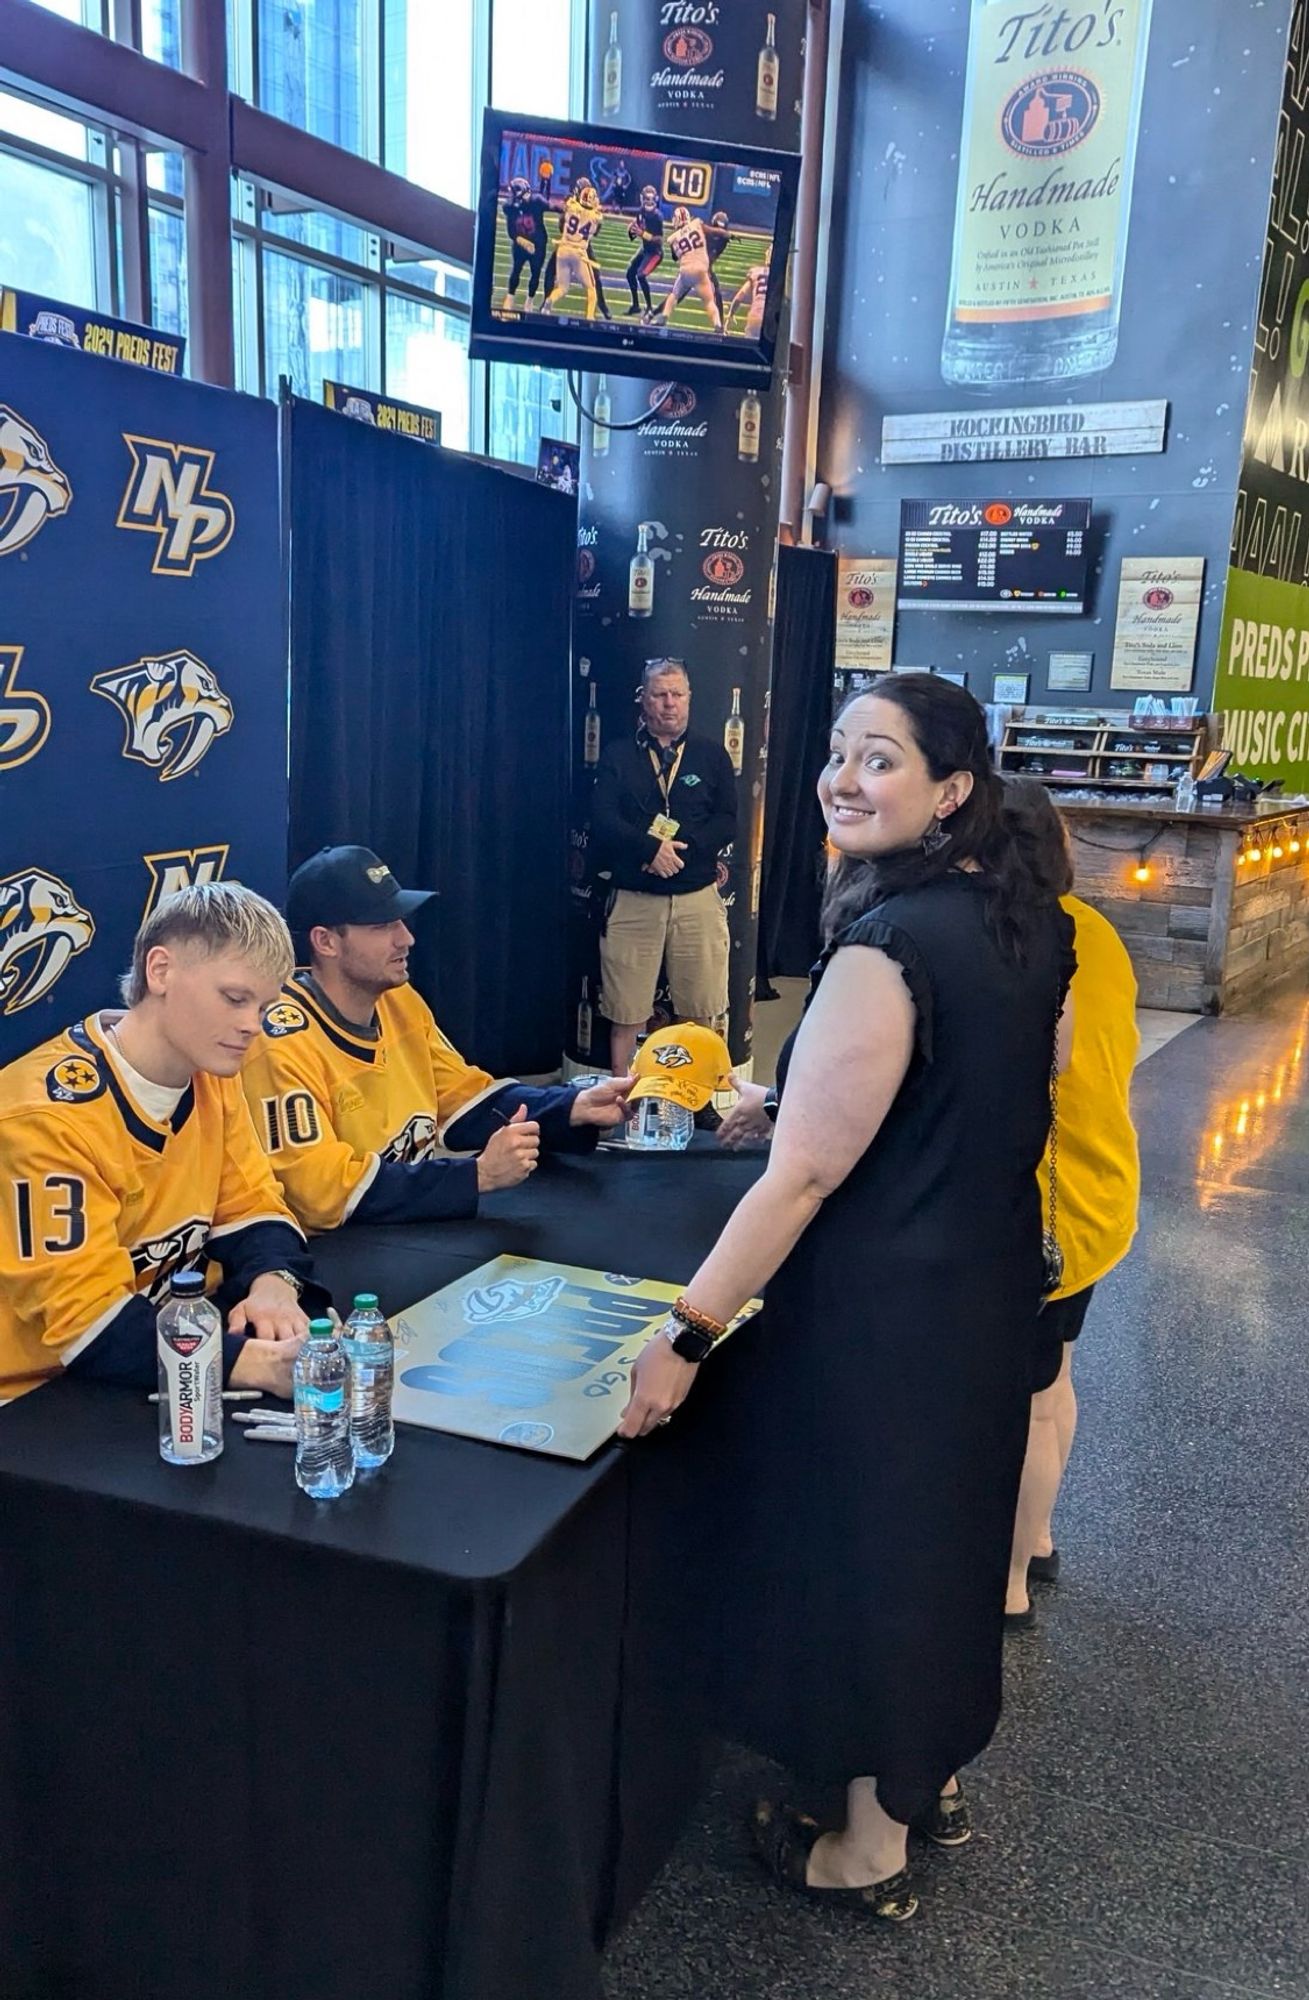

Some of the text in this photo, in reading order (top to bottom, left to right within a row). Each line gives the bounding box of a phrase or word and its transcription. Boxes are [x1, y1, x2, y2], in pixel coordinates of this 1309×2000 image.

[660, 0, 719, 25] Tito's
[994, 1, 1125, 64] Tito's
[650, 67, 724, 88] Handmade
[668, 90, 704, 99] VODKA
[672, 166, 704, 198] 40
[970, 158, 1120, 213] Handmade
[567, 215, 592, 241] 94
[999, 216, 1081, 241] VODKA
[678, 230, 704, 255] 92
[976, 271, 1096, 291] AUSTIN TEXAS
[84, 322, 179, 374] 2024 PREDS FEST
[637, 420, 708, 437] Handmade
[950, 412, 1085, 437] MOCKINGBIRD
[653, 439, 689, 448] VODKA
[940, 435, 1107, 461] DISTILLERY BAR
[928, 504, 982, 526] Tito's
[1013, 504, 1063, 518] Handmade
[1020, 517, 1055, 525] VODKA
[699, 527, 749, 549] Tito's
[845, 573, 879, 585] Tito's
[1141, 569, 1181, 584] Tito's
[690, 585, 752, 604] Handmade
[707, 605, 738, 615] VODKA
[1132, 613, 1183, 625] Handmade
[1228, 618, 1309, 681] PREDS P
[1221, 709, 1286, 767] MUSIC
[262, 1089, 325, 1154] 10
[13, 1172, 89, 1261] 13
[582, 1371, 628, 1398] GO
[179, 1361, 194, 1443] BODYARMOR
